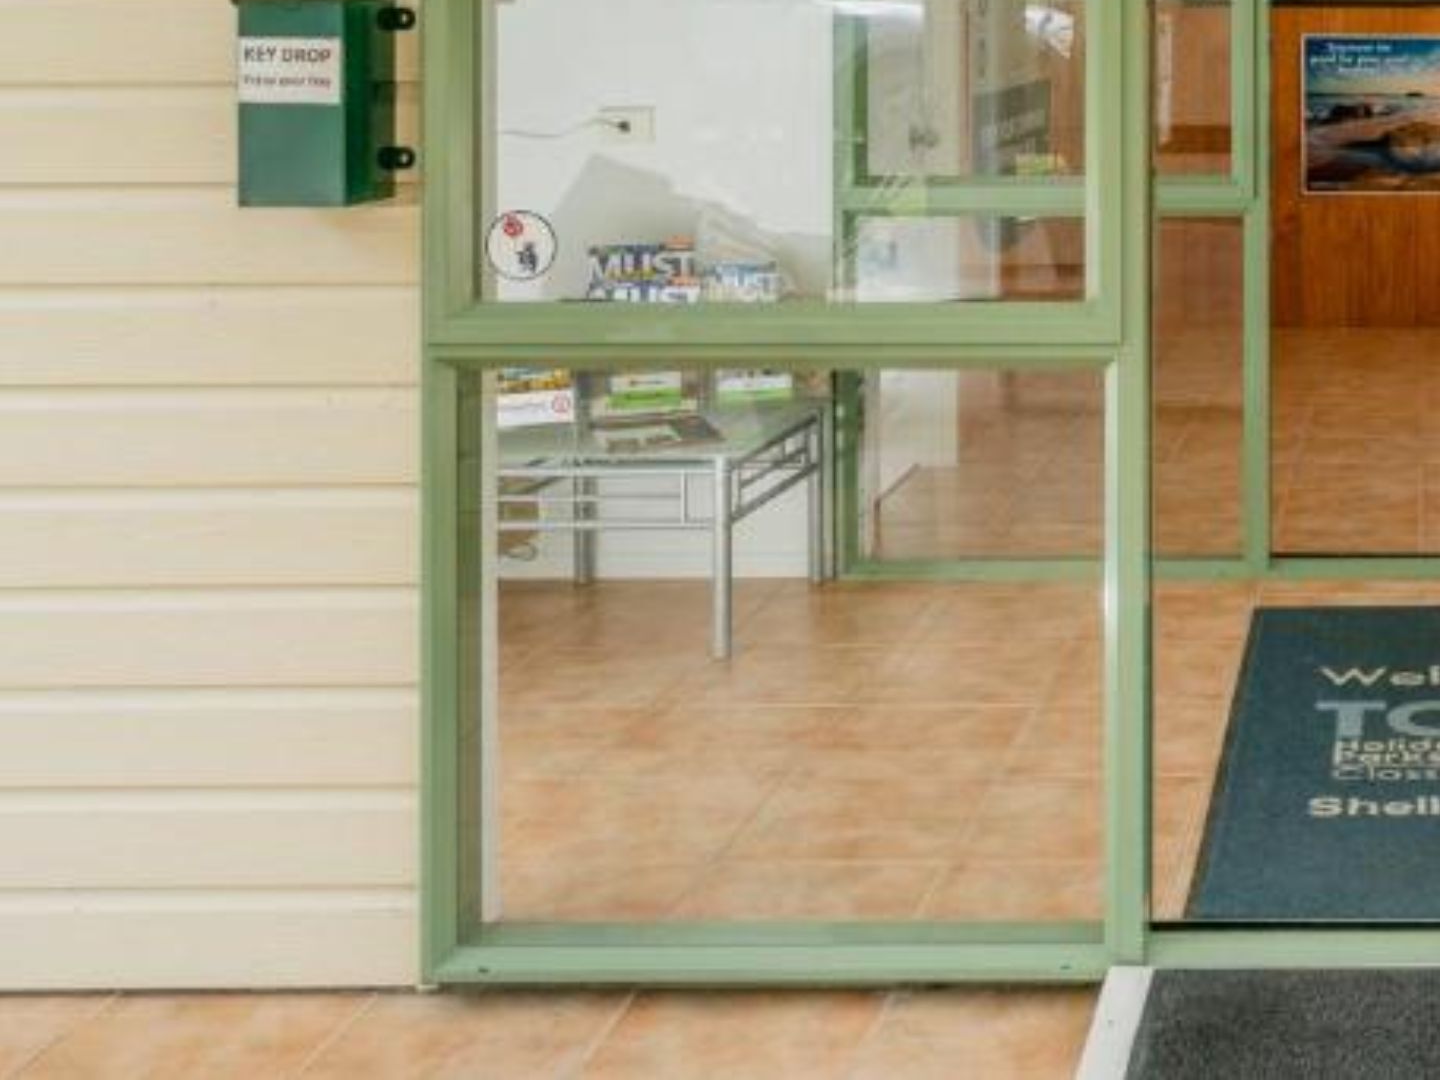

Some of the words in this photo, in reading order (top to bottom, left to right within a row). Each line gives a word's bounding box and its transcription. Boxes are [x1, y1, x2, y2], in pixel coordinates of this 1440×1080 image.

[244, 46, 277, 62] KEY
[281, 47, 331, 64] DROP
[588, 251, 698, 280] MUST
